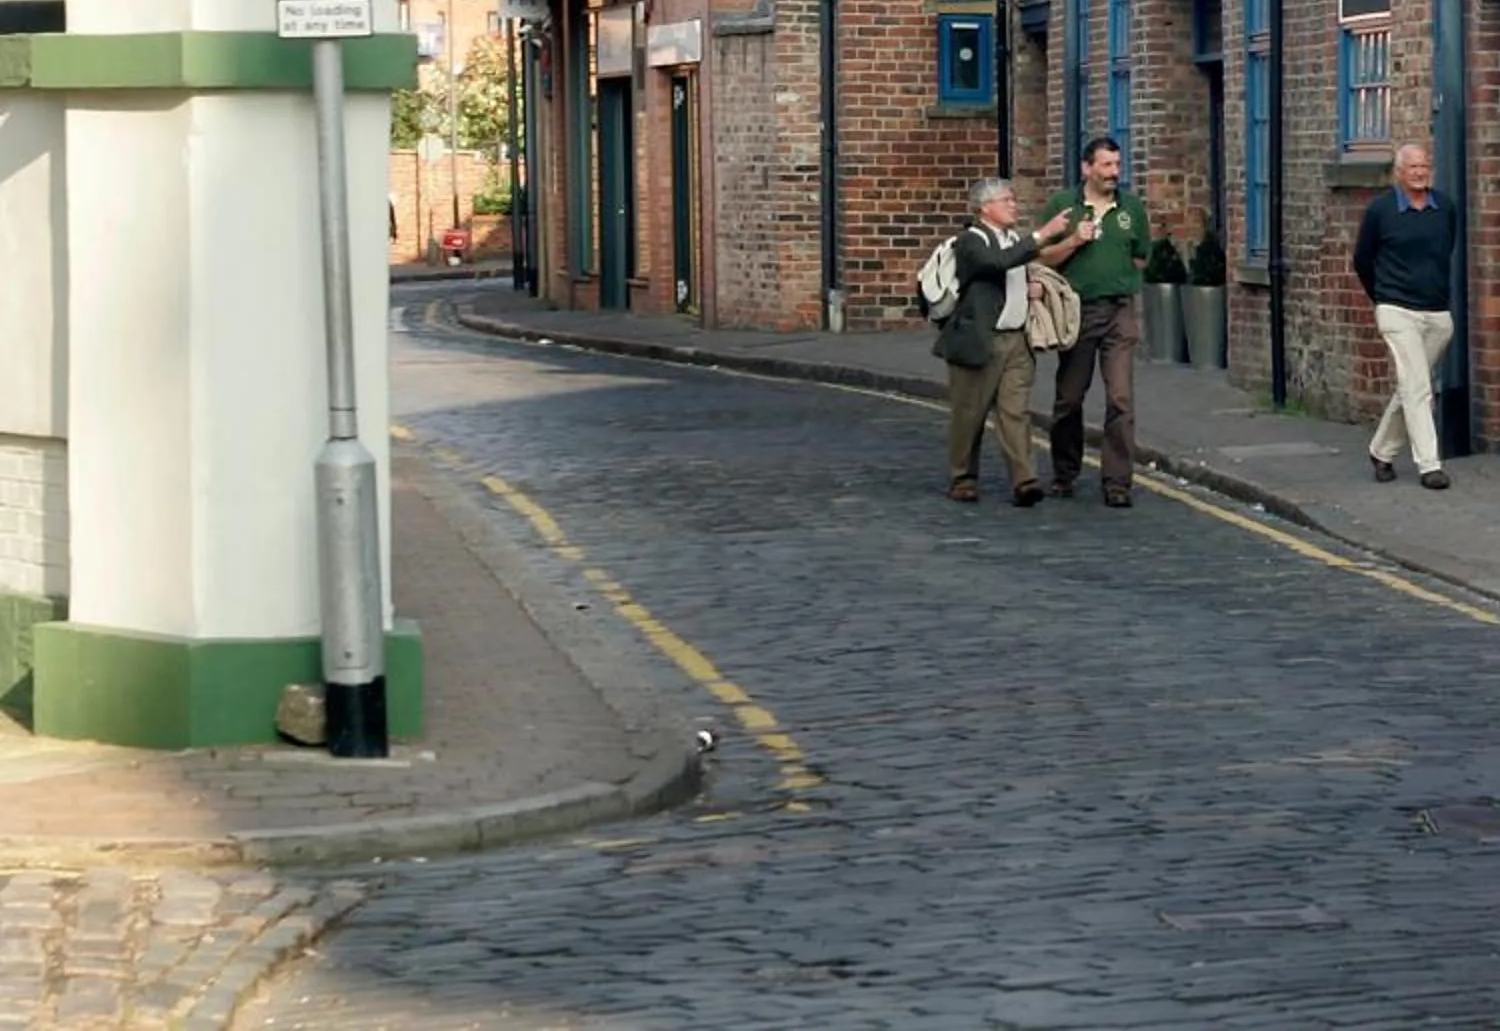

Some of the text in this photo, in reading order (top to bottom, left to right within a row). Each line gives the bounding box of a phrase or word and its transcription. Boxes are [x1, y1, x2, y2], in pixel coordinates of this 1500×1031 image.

[285, 4, 362, 19] No loading
[284, 19, 366, 34] at any time
